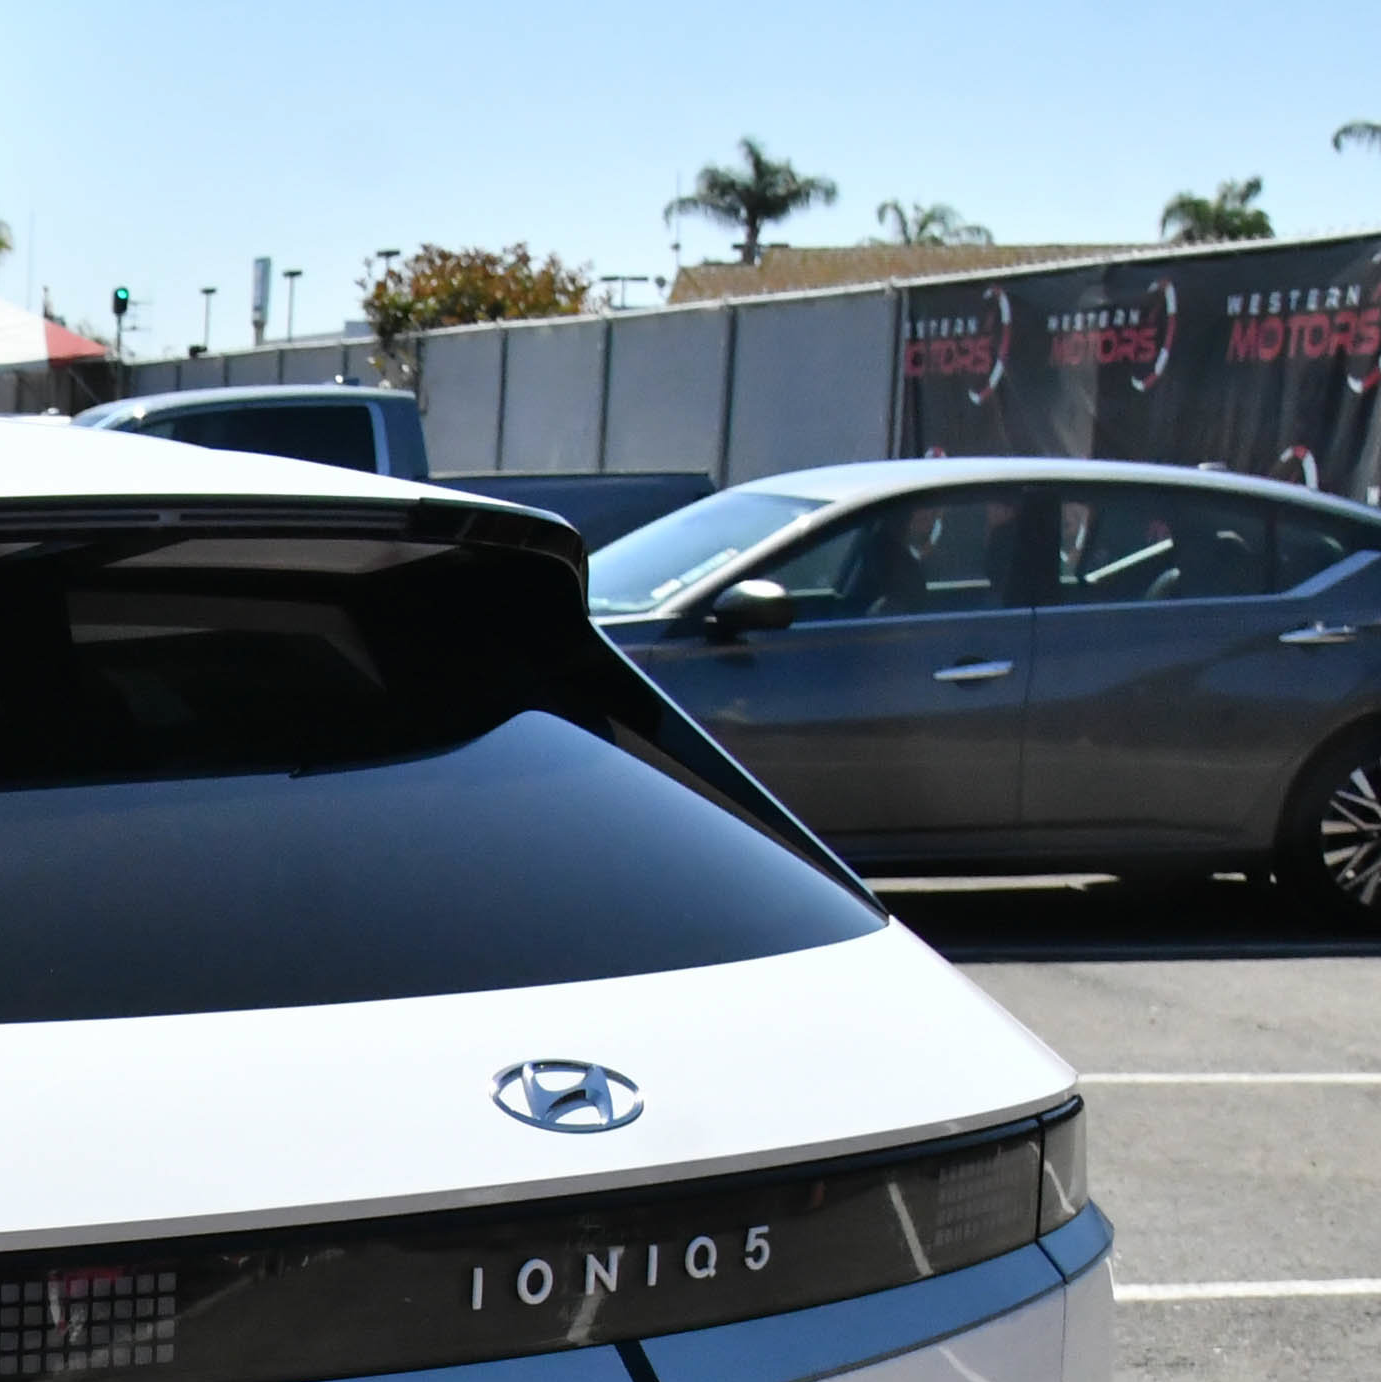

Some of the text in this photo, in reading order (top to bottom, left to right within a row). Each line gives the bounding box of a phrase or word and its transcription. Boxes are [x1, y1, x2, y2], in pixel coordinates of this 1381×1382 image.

[1227, 284, 1361, 316] WESTERN
[904, 335, 993, 377] OTORS
[1049, 327, 1157, 367] MOTORS
[1225, 308, 1381, 364] MOTORS
